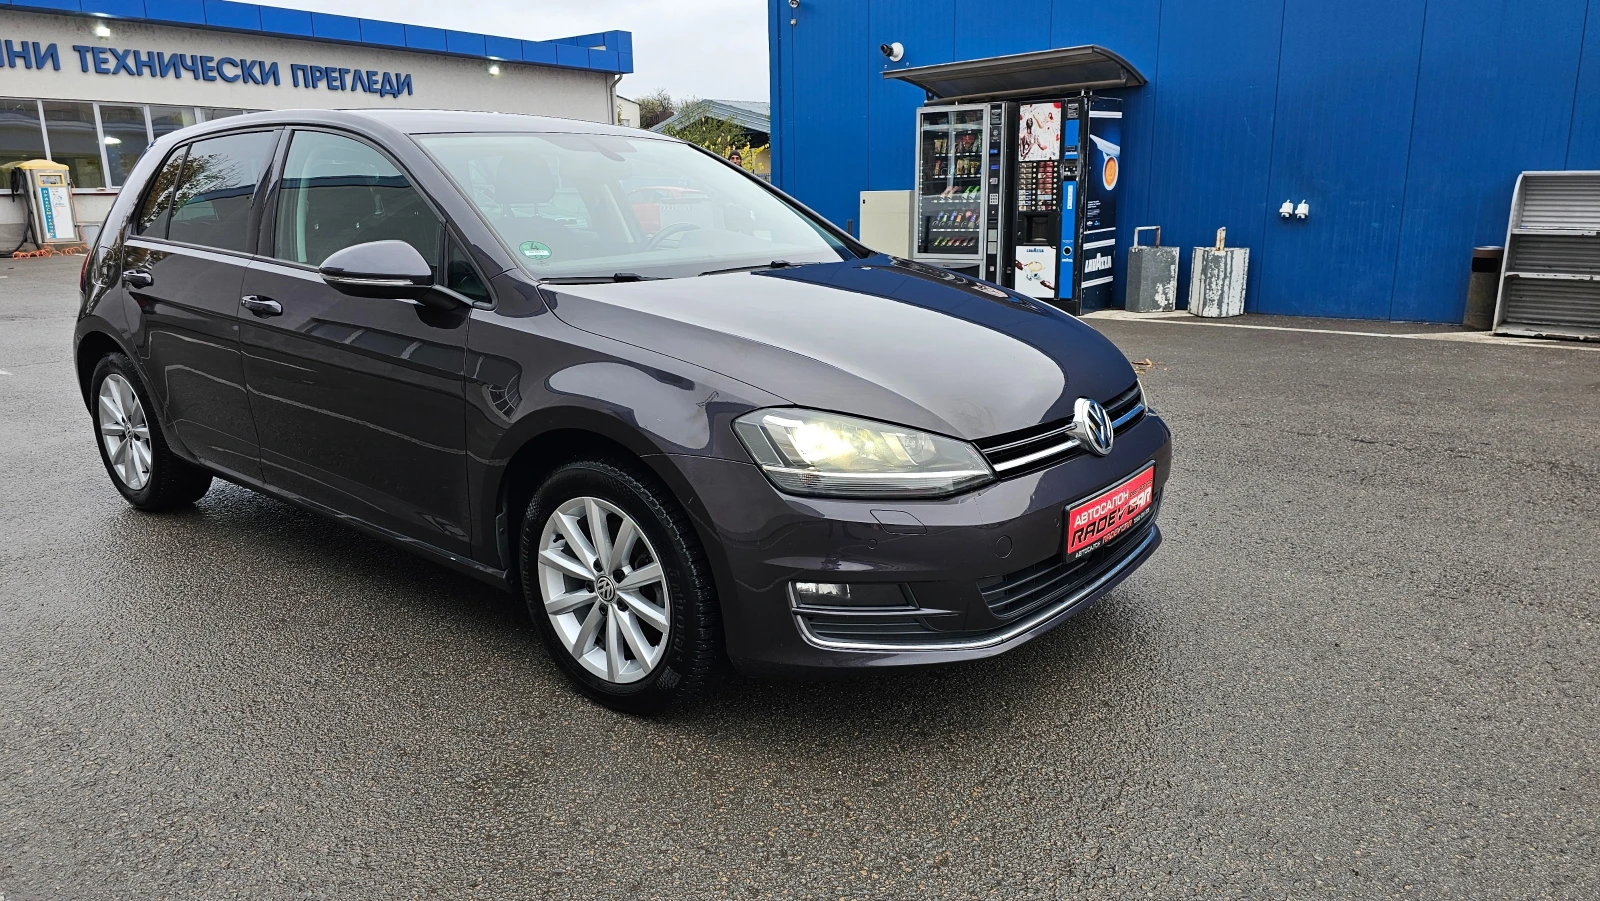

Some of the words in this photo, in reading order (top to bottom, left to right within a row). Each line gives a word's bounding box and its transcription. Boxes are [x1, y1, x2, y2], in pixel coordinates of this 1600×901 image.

[0, 39, 61, 71] НИ
[72, 44, 281, 87] ТЕХНИЧЕСКИ
[290, 63, 414, 99] ПРЕГЛЕДИ
[1084, 252, 1112, 273] LAVAZZA
[1074, 488, 1129, 529] АВТОСАЛОН
